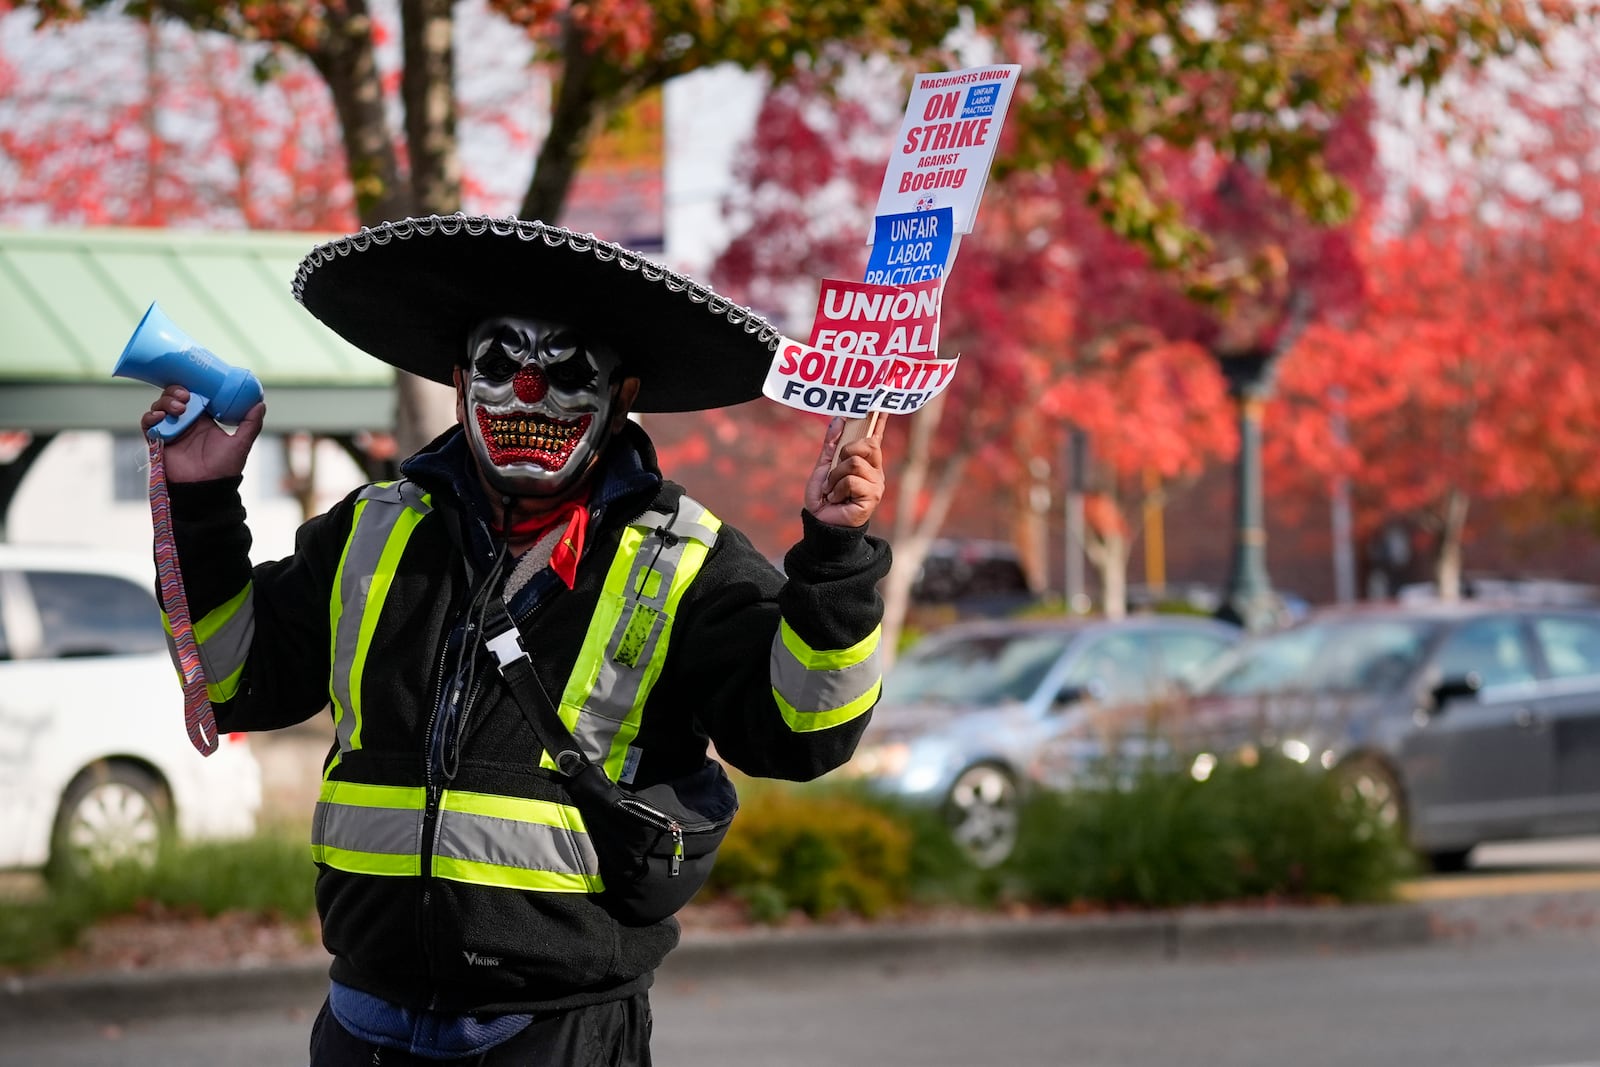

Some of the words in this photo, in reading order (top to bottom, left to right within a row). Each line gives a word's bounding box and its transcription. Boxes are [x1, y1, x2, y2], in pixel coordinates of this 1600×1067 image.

[920, 73, 978, 90] MACHINISTS
[979, 69, 1011, 81] UNION
[974, 87, 994, 96] UNFAIR
[923, 91, 961, 121] ON
[971, 96, 991, 105] LABOR
[903, 119, 991, 154] STRIKE
[917, 153, 960, 168] AGAINST
[898, 167, 967, 193] Boeing
[891, 216, 938, 241] UNFAIR
[887, 241, 933, 265] LABOR
[823, 286, 940, 321] UNION
[816, 329, 880, 354] FOR
[778, 345, 955, 390] SOLIDARITY
